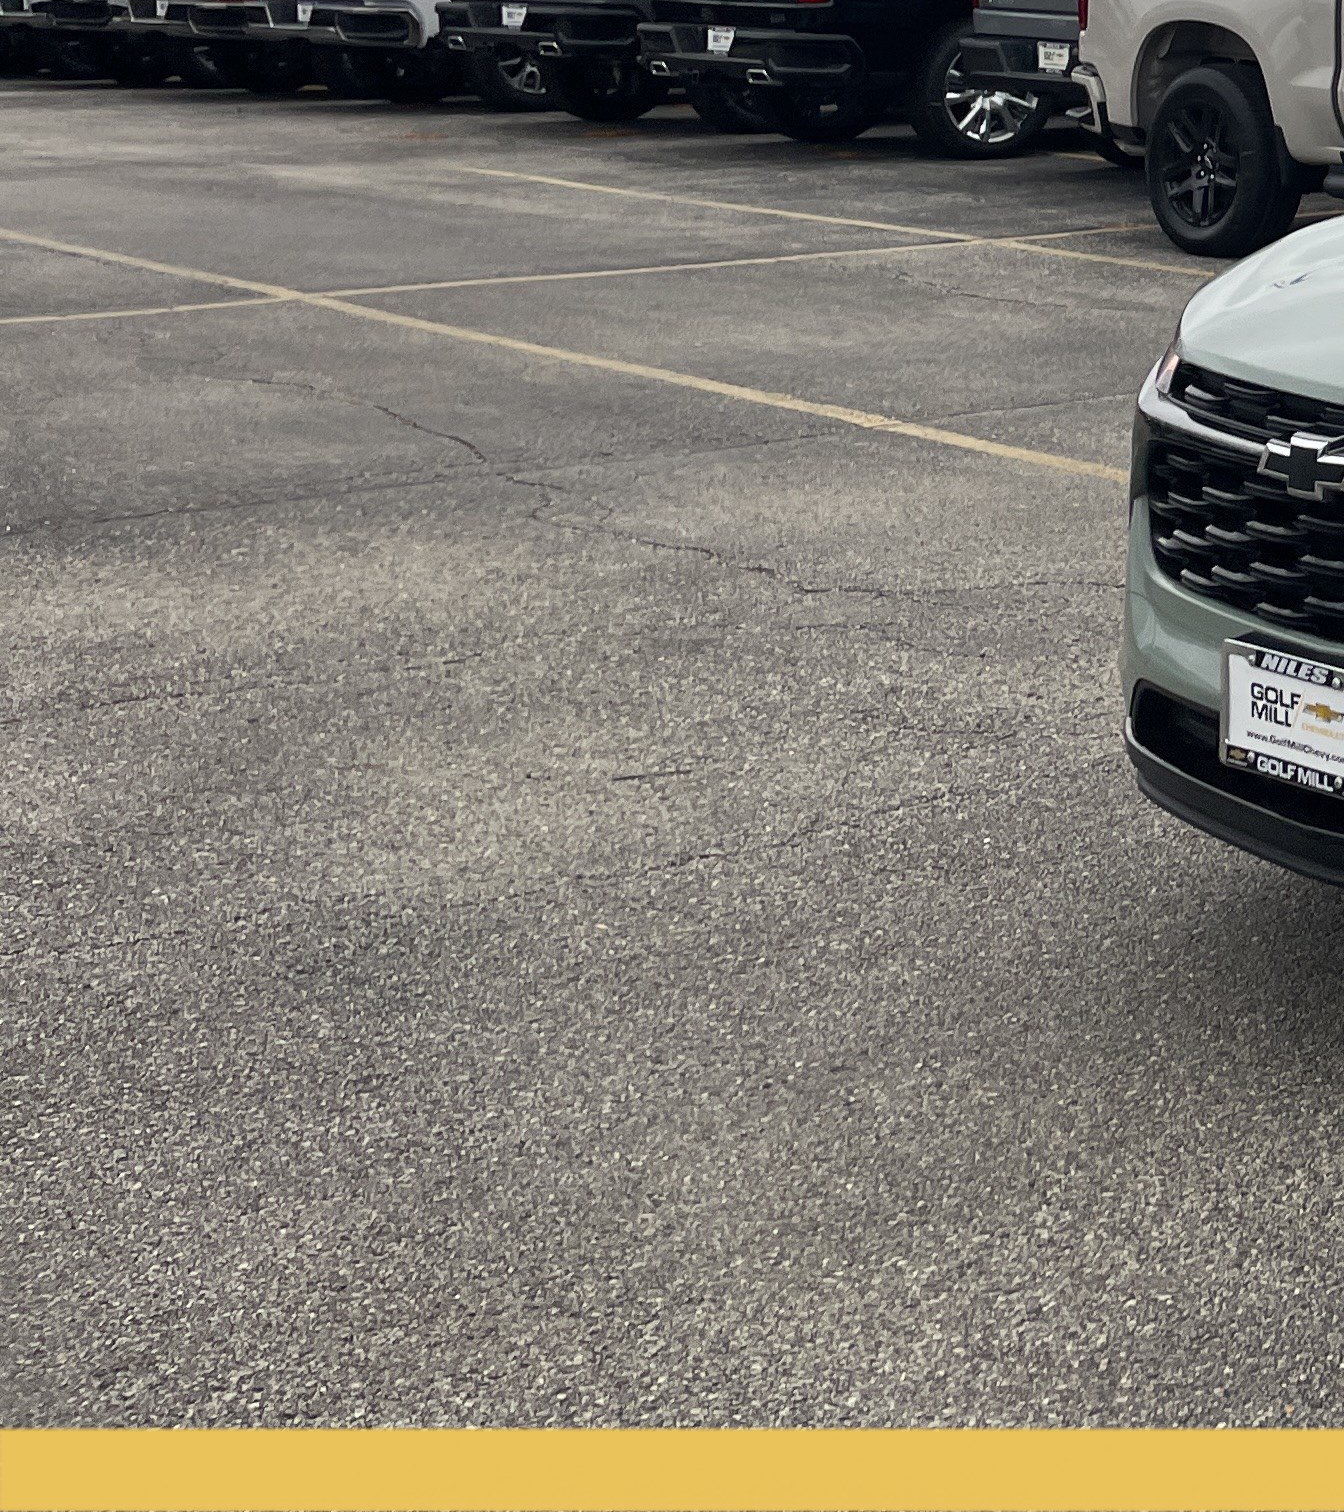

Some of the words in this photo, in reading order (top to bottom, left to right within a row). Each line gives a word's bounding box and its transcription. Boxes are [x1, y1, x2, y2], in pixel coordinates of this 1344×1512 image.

[1260, 654, 1329, 685] NILES
[1250, 682, 1302, 711] GOLF
[1251, 700, 1292, 728] MILL
[1256, 756, 1297, 781] GOLF
[1297, 769, 1334, 793] MILL
